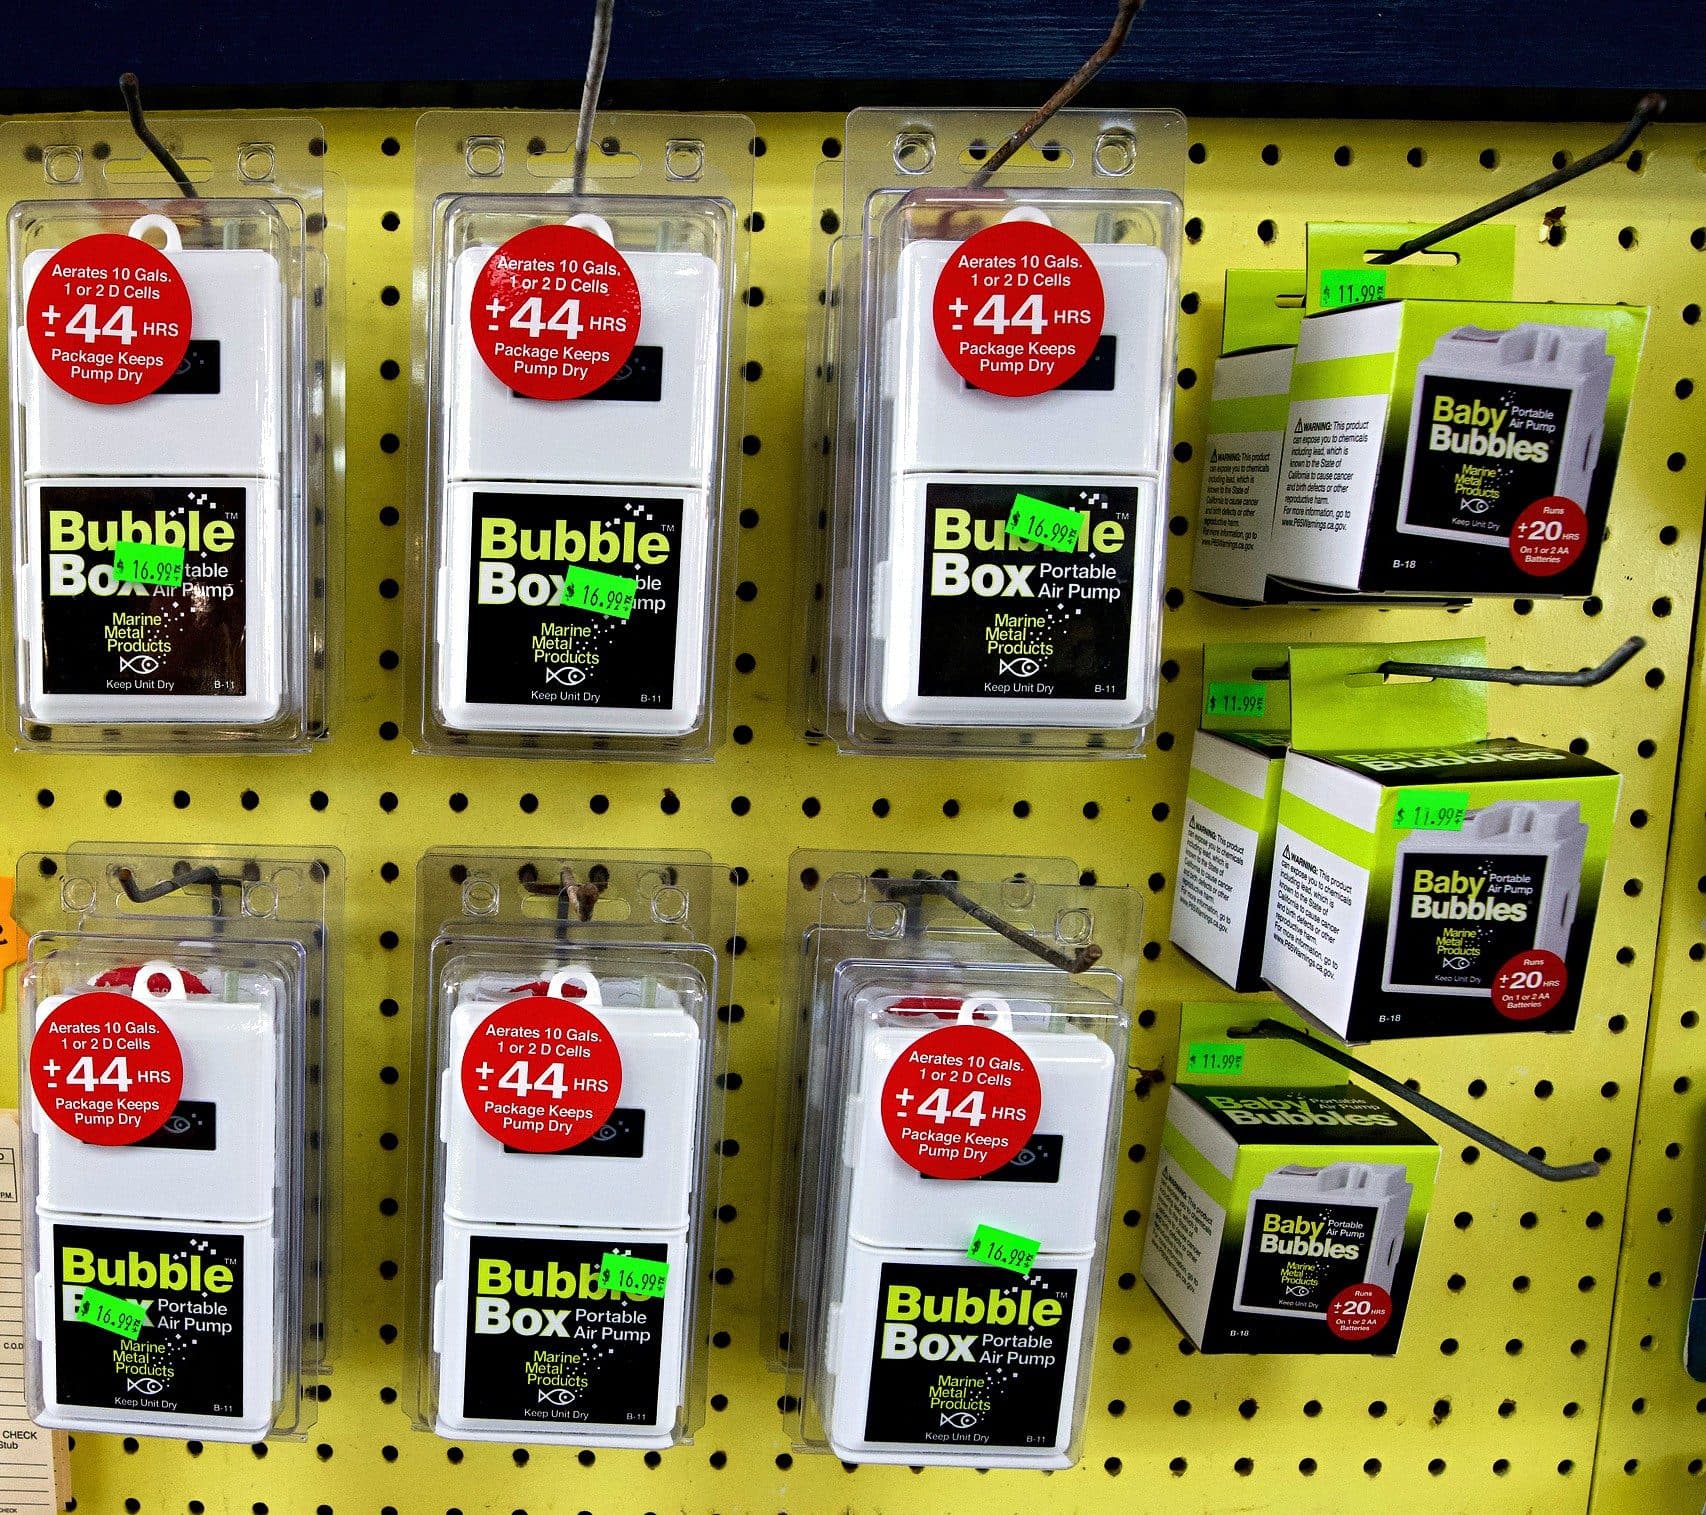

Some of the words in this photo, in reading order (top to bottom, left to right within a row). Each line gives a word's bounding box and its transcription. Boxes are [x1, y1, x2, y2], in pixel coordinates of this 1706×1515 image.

[498, 256, 554, 271] Aerates
[560, 260, 577, 272] 10
[583, 261, 620, 276] Gals.
[958, 256, 1016, 268] Aerates
[1021, 256, 1039, 268] 10
[1044, 255, 1082, 268] Gals.
[52, 264, 107, 279] Aerates
[112, 268, 130, 280] 10
[135, 268, 171, 282] Gals.
[65, 283, 70, 294] 1
[77, 285, 92, 295] or
[96, 285, 104, 296] 2
[109, 285, 119, 297] D
[124, 285, 160, 299] Cells
[590, 316, 626, 332] HRS
[1054, 310, 1091, 323] HRS
[143, 322, 178, 336] HRS
[960, 342, 1023, 358] Package
[1029, 342, 1075, 358] Keeps
[52, 349, 113, 365] Package
[118, 352, 163, 368] Keeps
[980, 360, 1023, 374] Pump
[1029, 360, 1055, 375] Dry
[71, 367, 113, 382] Pump
[118, 369, 142, 384] Dry
[1433, 395, 1508, 433] Baby
[1511, 406, 1554, 419] Portable
[1509, 420, 1524, 428] Air
[1526, 421, 1556, 433] Pump
[1429, 424, 1549, 463] Bubbles
[1462, 464, 1496, 477] Marine
[1455, 474, 1481, 486] Metal
[1455, 484, 1499, 499] Products
[49, 511, 235, 552] Bubble
[934, 508, 1124, 553] Bule
[480, 517, 670, 565] Bubble
[1393, 560, 1416, 568] B-18
[931, 553, 1036, 597] Box
[1040, 563, 1116, 579] Portable
[182, 583, 233, 600] Pump
[1038, 584, 1063, 598] Air
[1069, 584, 1120, 603] Pump
[113, 613, 161, 625] Marine
[995, 614, 1045, 627] Marine
[104, 626, 144, 638] Metal
[541, 623, 591, 637] Marine
[985, 627, 1026, 641] Metal
[107, 639, 171, 652] Products
[532, 636, 572, 650] Metal
[988, 641, 1053, 655] Products
[534, 650, 599, 664] Products
[531, 691, 557, 701] Keep
[560, 692, 580, 701] Unit
[583, 692, 600, 703] Dry
[1291, 853, 1319, 875] WARNING:
[1320, 869, 1330, 882] This
[1331, 879, 1352, 894] product
[1281, 860, 1290, 869] can
[1290, 866, 1307, 880] expose
[1308, 876, 1317, 887] you
[1325, 886, 1352, 906] chemicals
[1413, 870, 1486, 900] Baby
[1411, 895, 1527, 922] Bubbles
[49, 1022, 100, 1033] Aerates
[105, 1023, 120, 1033] 10
[125, 1023, 159, 1033] Gals.
[909, 1051, 963, 1066] Aerates
[968, 1057, 984, 1068] 10
[989, 1058, 1024, 1072] Gals.
[138, 1071, 171, 1082] HRS
[573, 1078, 608, 1092] HRS
[56, 1098, 113, 1112] Package
[117, 1099, 159, 1113] Keeps
[485, 1101, 545, 1116] Package
[549, 1105, 593, 1119] Keeps
[1205, 1096, 1311, 1114] Baby
[75, 1113, 114, 1127] Pump
[118, 1115, 141, 1127] Dry
[992, 1106, 1026, 1120] HRS
[1223, 1111, 1398, 1126] Bubbles
[503, 1118, 544, 1133] Pump
[549, 1120, 573, 1135] Dry
[902, 1128, 961, 1144] Package
[965, 1133, 1008, 1148] Keeps
[919, 1144, 959, 1159] Pump
[964, 1148, 987, 1163] Dry
[1263, 1213, 1324, 1241] Baby
[1328, 1220, 1363, 1229] Portable
[1340, 1229, 1364, 1239] Pump
[1260, 1234, 1359, 1260] Bubbles
[62, 1247, 233, 1293] Bubble
[158, 1299, 227, 1315] Portable
[886, 1285, 1062, 1327] Bubble
[475, 1296, 571, 1337] Box
[575, 1309, 647, 1324] Portable
[158, 1316, 180, 1329] Air
[185, 1318, 232, 1335] Pump
[574, 1326, 597, 1339] Air
[601, 1327, 650, 1344] Pump
[881, 1323, 978, 1362] Box
[982, 1334, 1052, 1349] Portable
[121, 1340, 165, 1353] Marine
[113, 1351, 149, 1363] Metal
[534, 1351, 580, 1363] Marine
[980, 1351, 1003, 1364] Air
[1007, 1351, 1055, 1368] Pump
[116, 1362, 174, 1377] Products
[525, 1362, 562, 1374] Metal
[528, 1374, 588, 1387] Products
[938, 1375, 984, 1388] Marine
[929, 1386, 966, 1398] Metal
[930, 1398, 990, 1410] Products
[2, 1431, 37, 1440] CHECK
[926, 1432, 949, 1441] Keep
[952, 1433, 971, 1441] Unit
[974, 1433, 989, 1443] Dry
